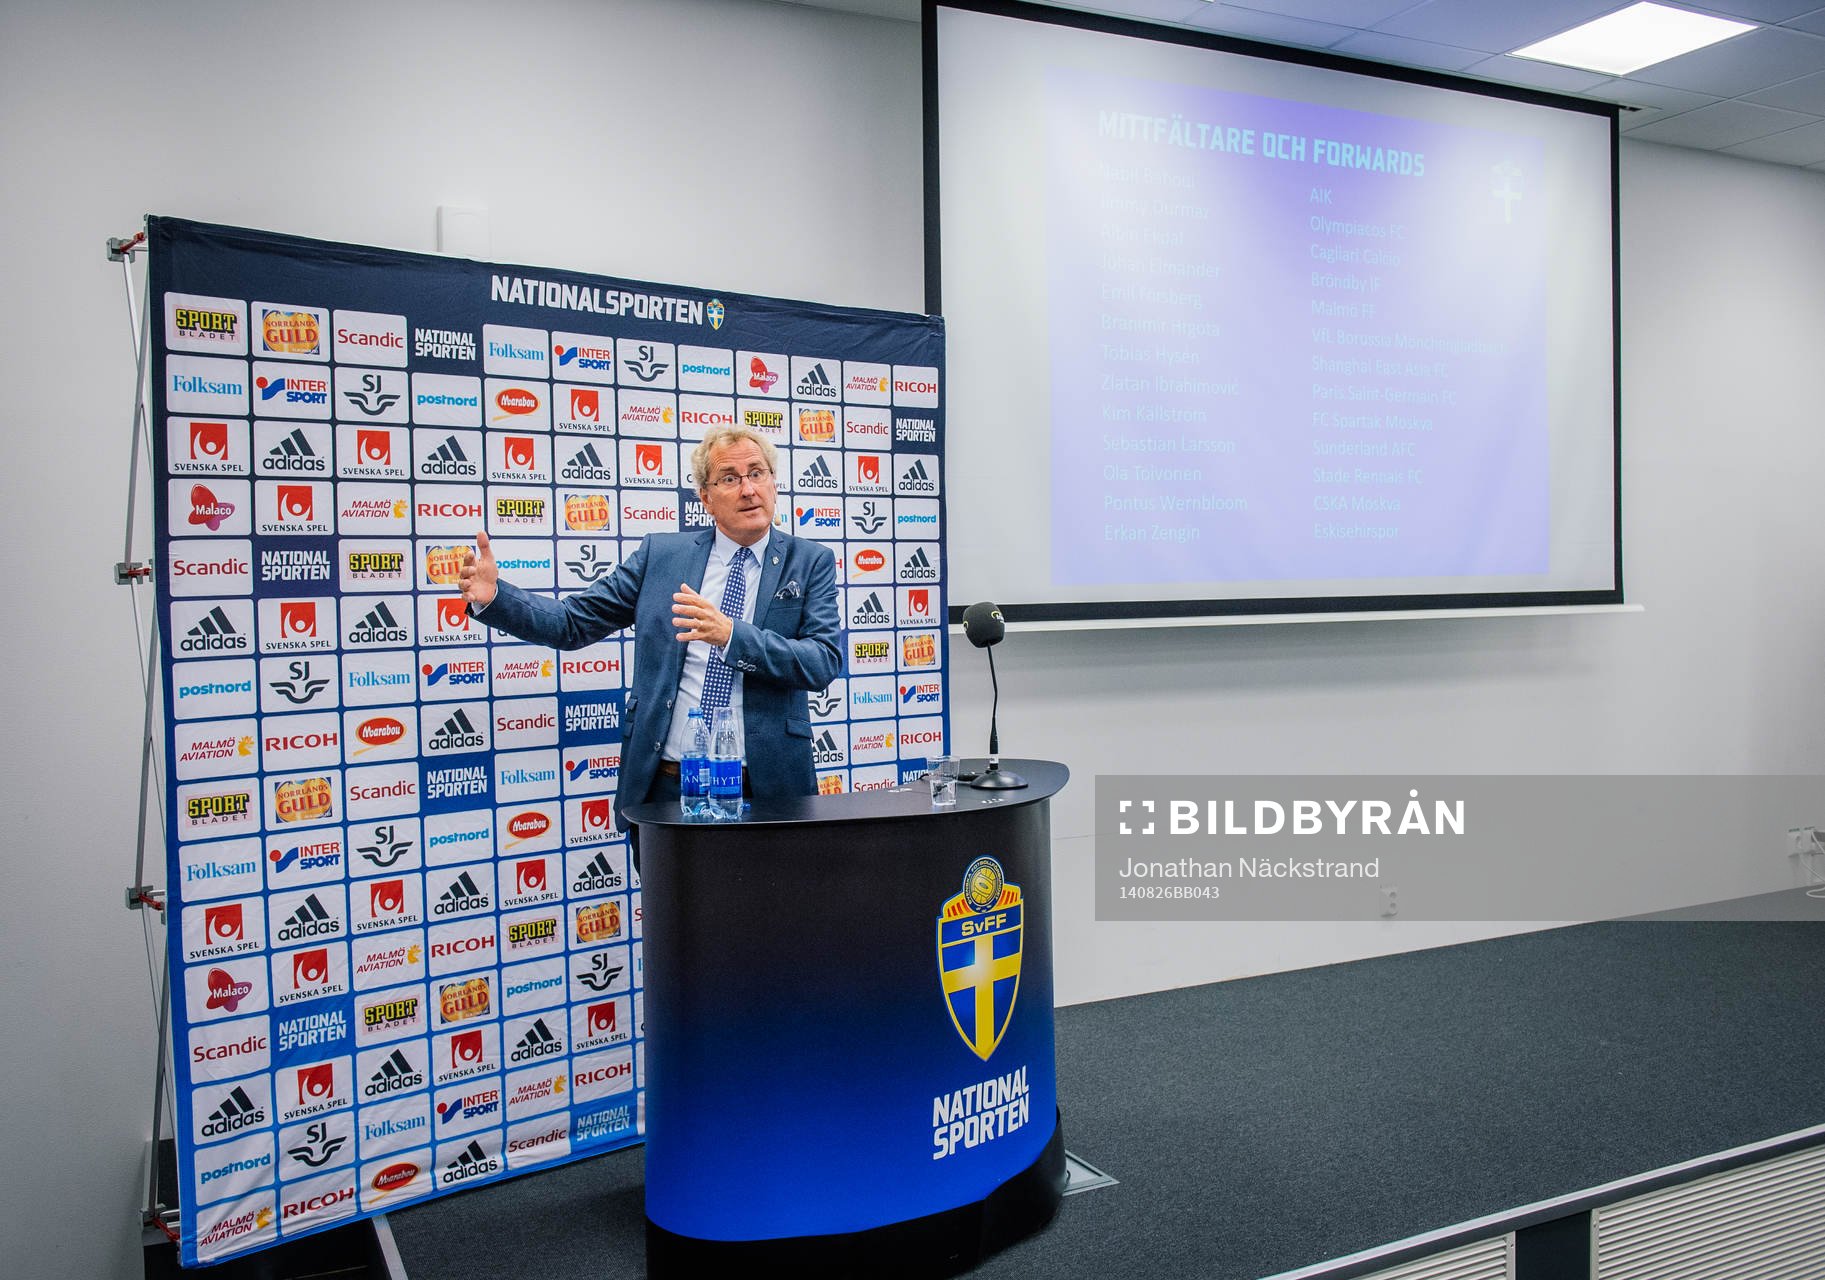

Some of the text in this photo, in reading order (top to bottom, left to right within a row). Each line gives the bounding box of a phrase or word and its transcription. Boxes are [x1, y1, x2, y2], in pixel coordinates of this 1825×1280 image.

[1098, 110, 1425, 177] MITTFÄLTARE OCH FORWARDS
[1309, 188, 1332, 204] AIK
[492, 275, 703, 325] NATIONALSPORTEN
[175, 308, 238, 333] SPORT
[415, 328, 475, 347] NATIONAL
[415, 342, 476, 361] SPORTEN
[639, 346, 654, 362] SJ
[579, 359, 610, 371] SPORT
[682, 364, 730, 376] postnord
[173, 374, 242, 395] Folksam
[286, 378, 327, 392] INTER
[362, 375, 382, 393] SJ
[797, 385, 836, 397] adidas
[895, 381, 937, 393] RICOH
[286, 390, 327, 404] SPORT
[417, 394, 477, 407] postnord
[559, 423, 610, 432] SVENSKA SPEL
[745, 411, 783, 428] SPORT
[896, 418, 936, 430] NATIONAL
[846, 422, 888, 435] Scandic
[896, 429, 936, 442] SPORTEN
[174, 463, 244, 472] SVENSKA SPEL
[263, 456, 325, 472] adidas
[342, 467, 404, 477] SVENSKA SPEL
[421, 459, 477, 476] adidas
[562, 466, 610, 480] adidas
[798, 476, 837, 488] adidas
[899, 481, 934, 491] adidas
[341, 509, 390, 518] AVIATION
[418, 503, 482, 517] RICOH
[496, 499, 545, 517] SPORT
[624, 507, 676, 520] Scandic
[815, 508, 840, 517] INTER
[863, 502, 875, 516] SJ
[261, 523, 328, 532] SVENSKA SPEL
[815, 517, 840, 527] SPORT
[898, 515, 936, 524] postnord
[262, 550, 330, 566] NATIONAL
[580, 545, 596, 562] SJ
[173, 559, 248, 576] Scandic
[349, 553, 404, 572] SPORT
[262, 564, 330, 581] SPORTEN
[901, 567, 935, 579] adidas
[853, 613, 889, 624] adidas
[180, 633, 247, 651] adidas
[266, 641, 307, 650] SVENSKA
[855, 643, 889, 658] SPORT
[289, 661, 310, 681] SJ
[562, 660, 620, 673] RICOH
[349, 671, 410, 687] Folksam
[496, 671, 538, 680] AVIATION
[916, 684, 939, 693] INTER
[917, 694, 940, 702] SPORT
[565, 703, 618, 718] NATIONAL
[497, 714, 555, 731] Scandic
[566, 715, 619, 732] SPORTEN
[266, 733, 337, 751] RICOH
[429, 734, 483, 750] adidas
[901, 732, 941, 744] RICOH
[180, 749, 233, 762] AVIATION
[427, 767, 487, 784] NATIONAL
[501, 769, 555, 785] Folksam
[350, 781, 416, 800] Scandic
[427, 779, 487, 799] SPORTEN
[188, 794, 249, 818] SPORT
[278, 792, 330, 815] GULD
[375, 826, 394, 844] SJ
[429, 828, 489, 848] postnord
[300, 842, 339, 856] INTER
[300, 854, 340, 869] SPORT
[187, 861, 256, 882] Folksam
[434, 896, 489, 915] adidas
[504, 892, 558, 906] SVENSKA SPEL
[278, 921, 339, 942] adidas
[357, 916, 418, 930] SVENSKA SPEL
[962, 914, 1007, 937] SvFF
[431, 936, 495, 957] RICOH
[356, 959, 403, 973] AVIATION
[592, 953, 608, 970] SJ
[279, 984, 343, 1003] SVENSKA SPEL
[507, 976, 562, 997] postnord
[365, 999, 417, 1025] SPORT
[279, 1010, 346, 1036] NATIONAL
[279, 1024, 346, 1051] SPORTEN
[576, 1033, 627, 1049] SVENSKA SPEL
[193, 1036, 267, 1062] Scandic
[511, 1040, 562, 1062] adidas
[439, 1064, 495, 1082] SVENSKA SPEL
[575, 1063, 632, 1087] RICOH
[365, 1073, 422, 1097] adidas
[464, 1090, 498, 1108] INTER
[509, 1088, 551, 1106] AVIATION
[933, 1065, 1029, 1128] NATIONAL
[284, 1099, 347, 1120] SVENSKA SPEL
[464, 1102, 499, 1119] SPORT
[577, 1105, 630, 1128] NATIONAL
[307, 1122, 326, 1144] SJ
[365, 1115, 426, 1140] Folksam
[576, 1116, 630, 1142] SPORTEN
[933, 1093, 1029, 1160] SPORTEN
[201, 1153, 270, 1184] postnord
[283, 1187, 354, 1218] RICOH
